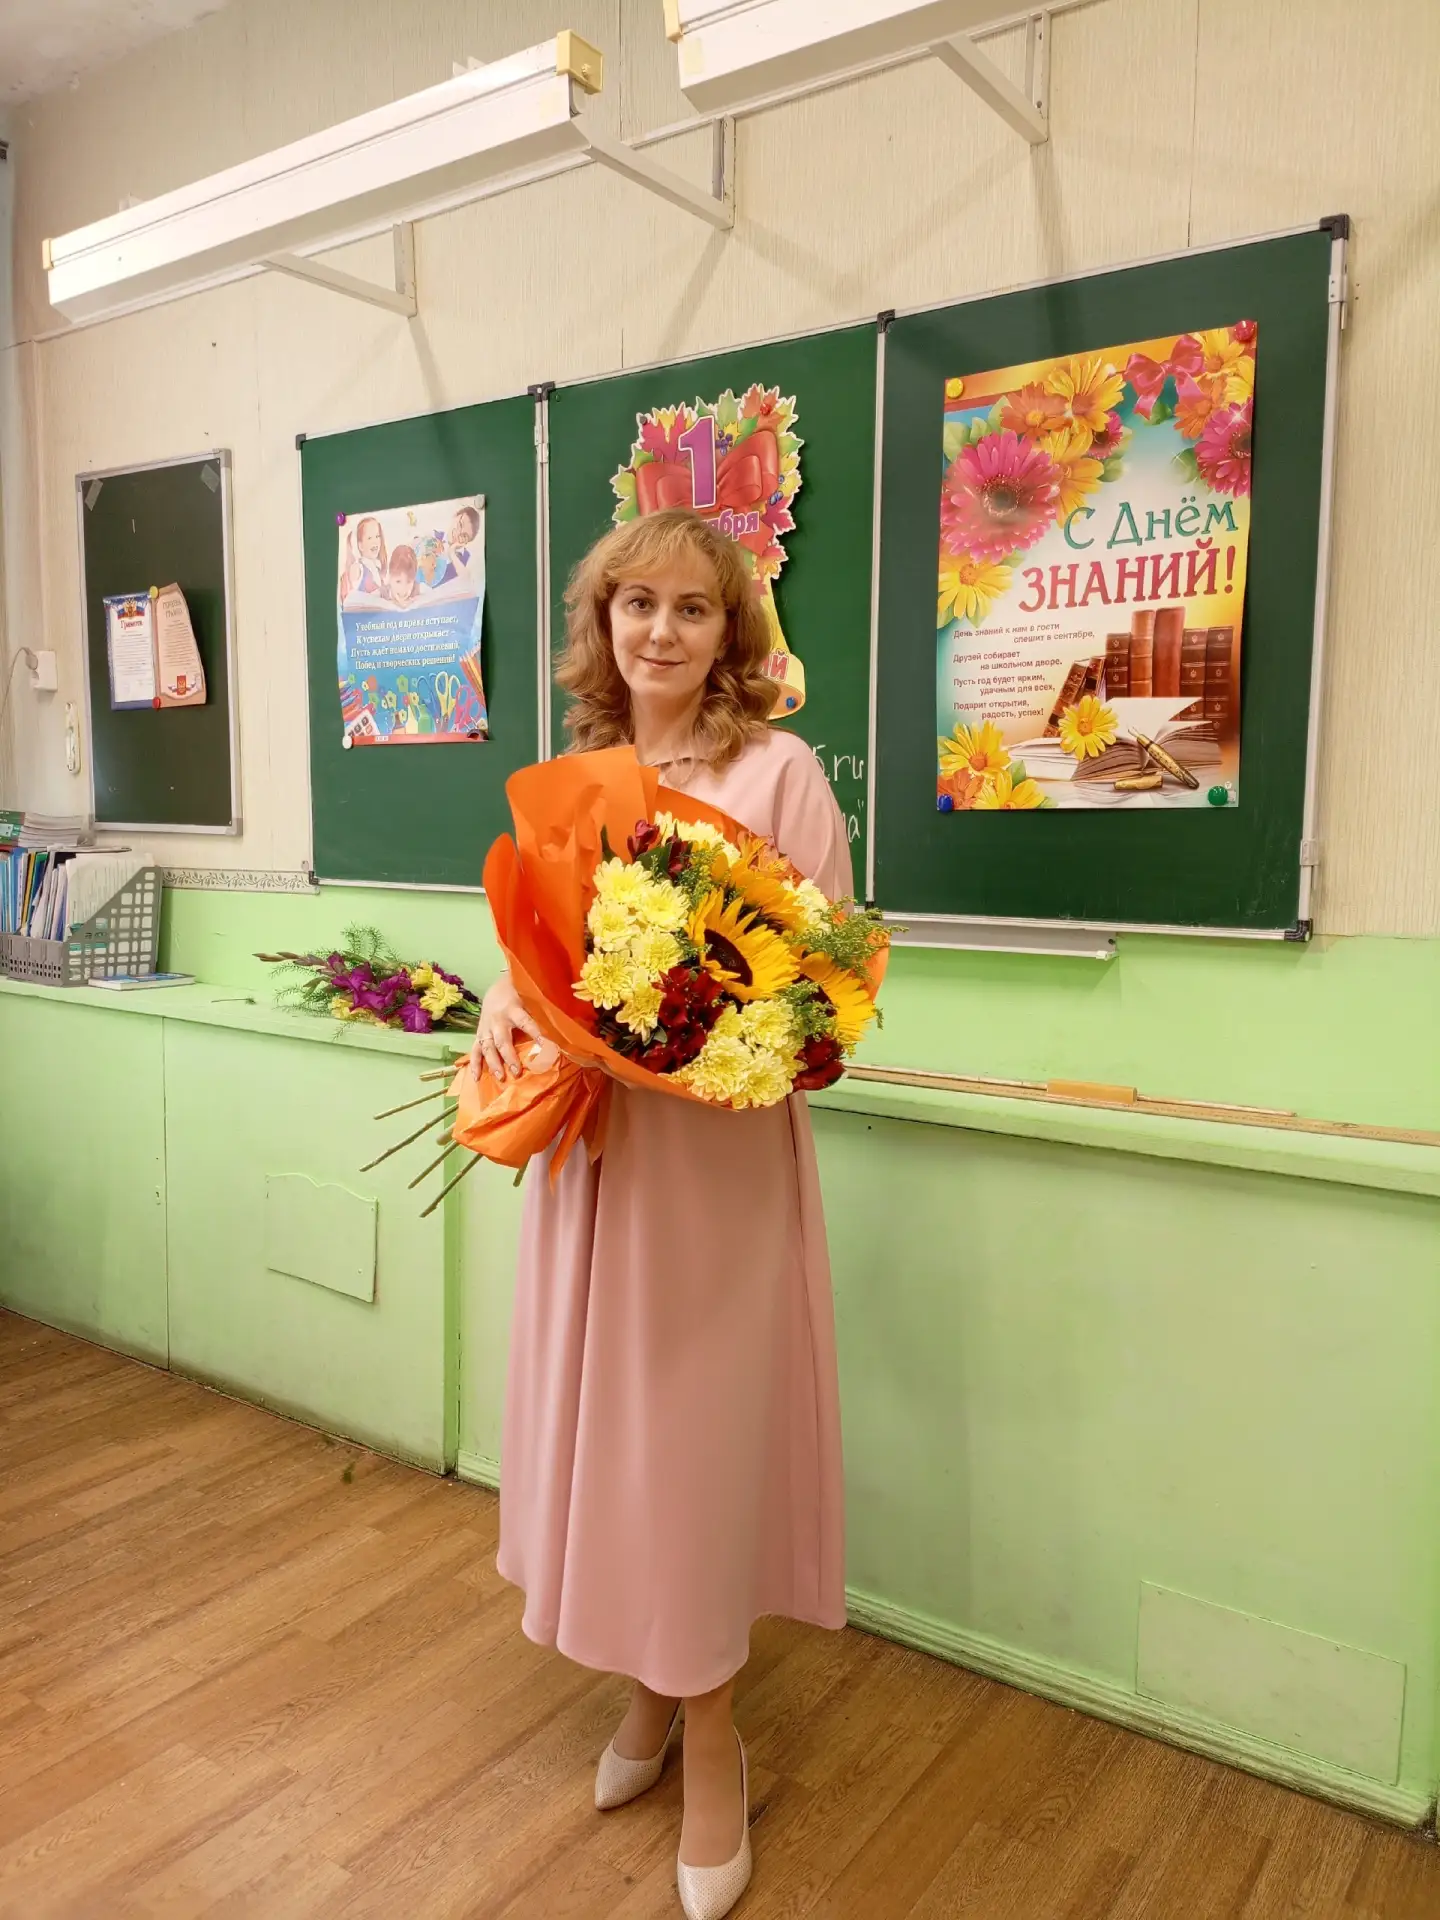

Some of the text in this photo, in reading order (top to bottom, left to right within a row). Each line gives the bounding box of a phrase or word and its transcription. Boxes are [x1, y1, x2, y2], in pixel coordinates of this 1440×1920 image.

[678, 414, 716, 509] 1
[701, 508, 760, 542] ября
[1063, 495, 1239, 550] С Днём
[1018, 537, 1236, 613] ЗНАНИЙ!
[355, 621, 385, 631] Учебный
[386, 621, 398, 631] год
[953, 630, 973, 640] День
[974, 626, 1004, 637] знаний
[1011, 625, 1028, 633] нам
[1036, 623, 1060, 632] гости
[362, 634, 391, 646] успехам
[391, 632, 412, 643] двери
[1013, 635, 1044, 644] спешит
[1053, 630, 1095, 640] сентябре,
[351, 648, 371, 659] Пусть
[953, 651, 1021, 663] Друзей собирает
[355, 660, 376, 670] Побед
[382, 658, 421, 669] творческих
[422, 654, 456, 667] решений!
[991, 660, 1033, 670] школьном
[953, 674, 1046, 688] Пусть год будет ярким,
[979, 683, 1056, 697] удачным для всех,
[953, 701, 987, 711] Подарит
[981, 707, 1044, 720] радость, успех!
